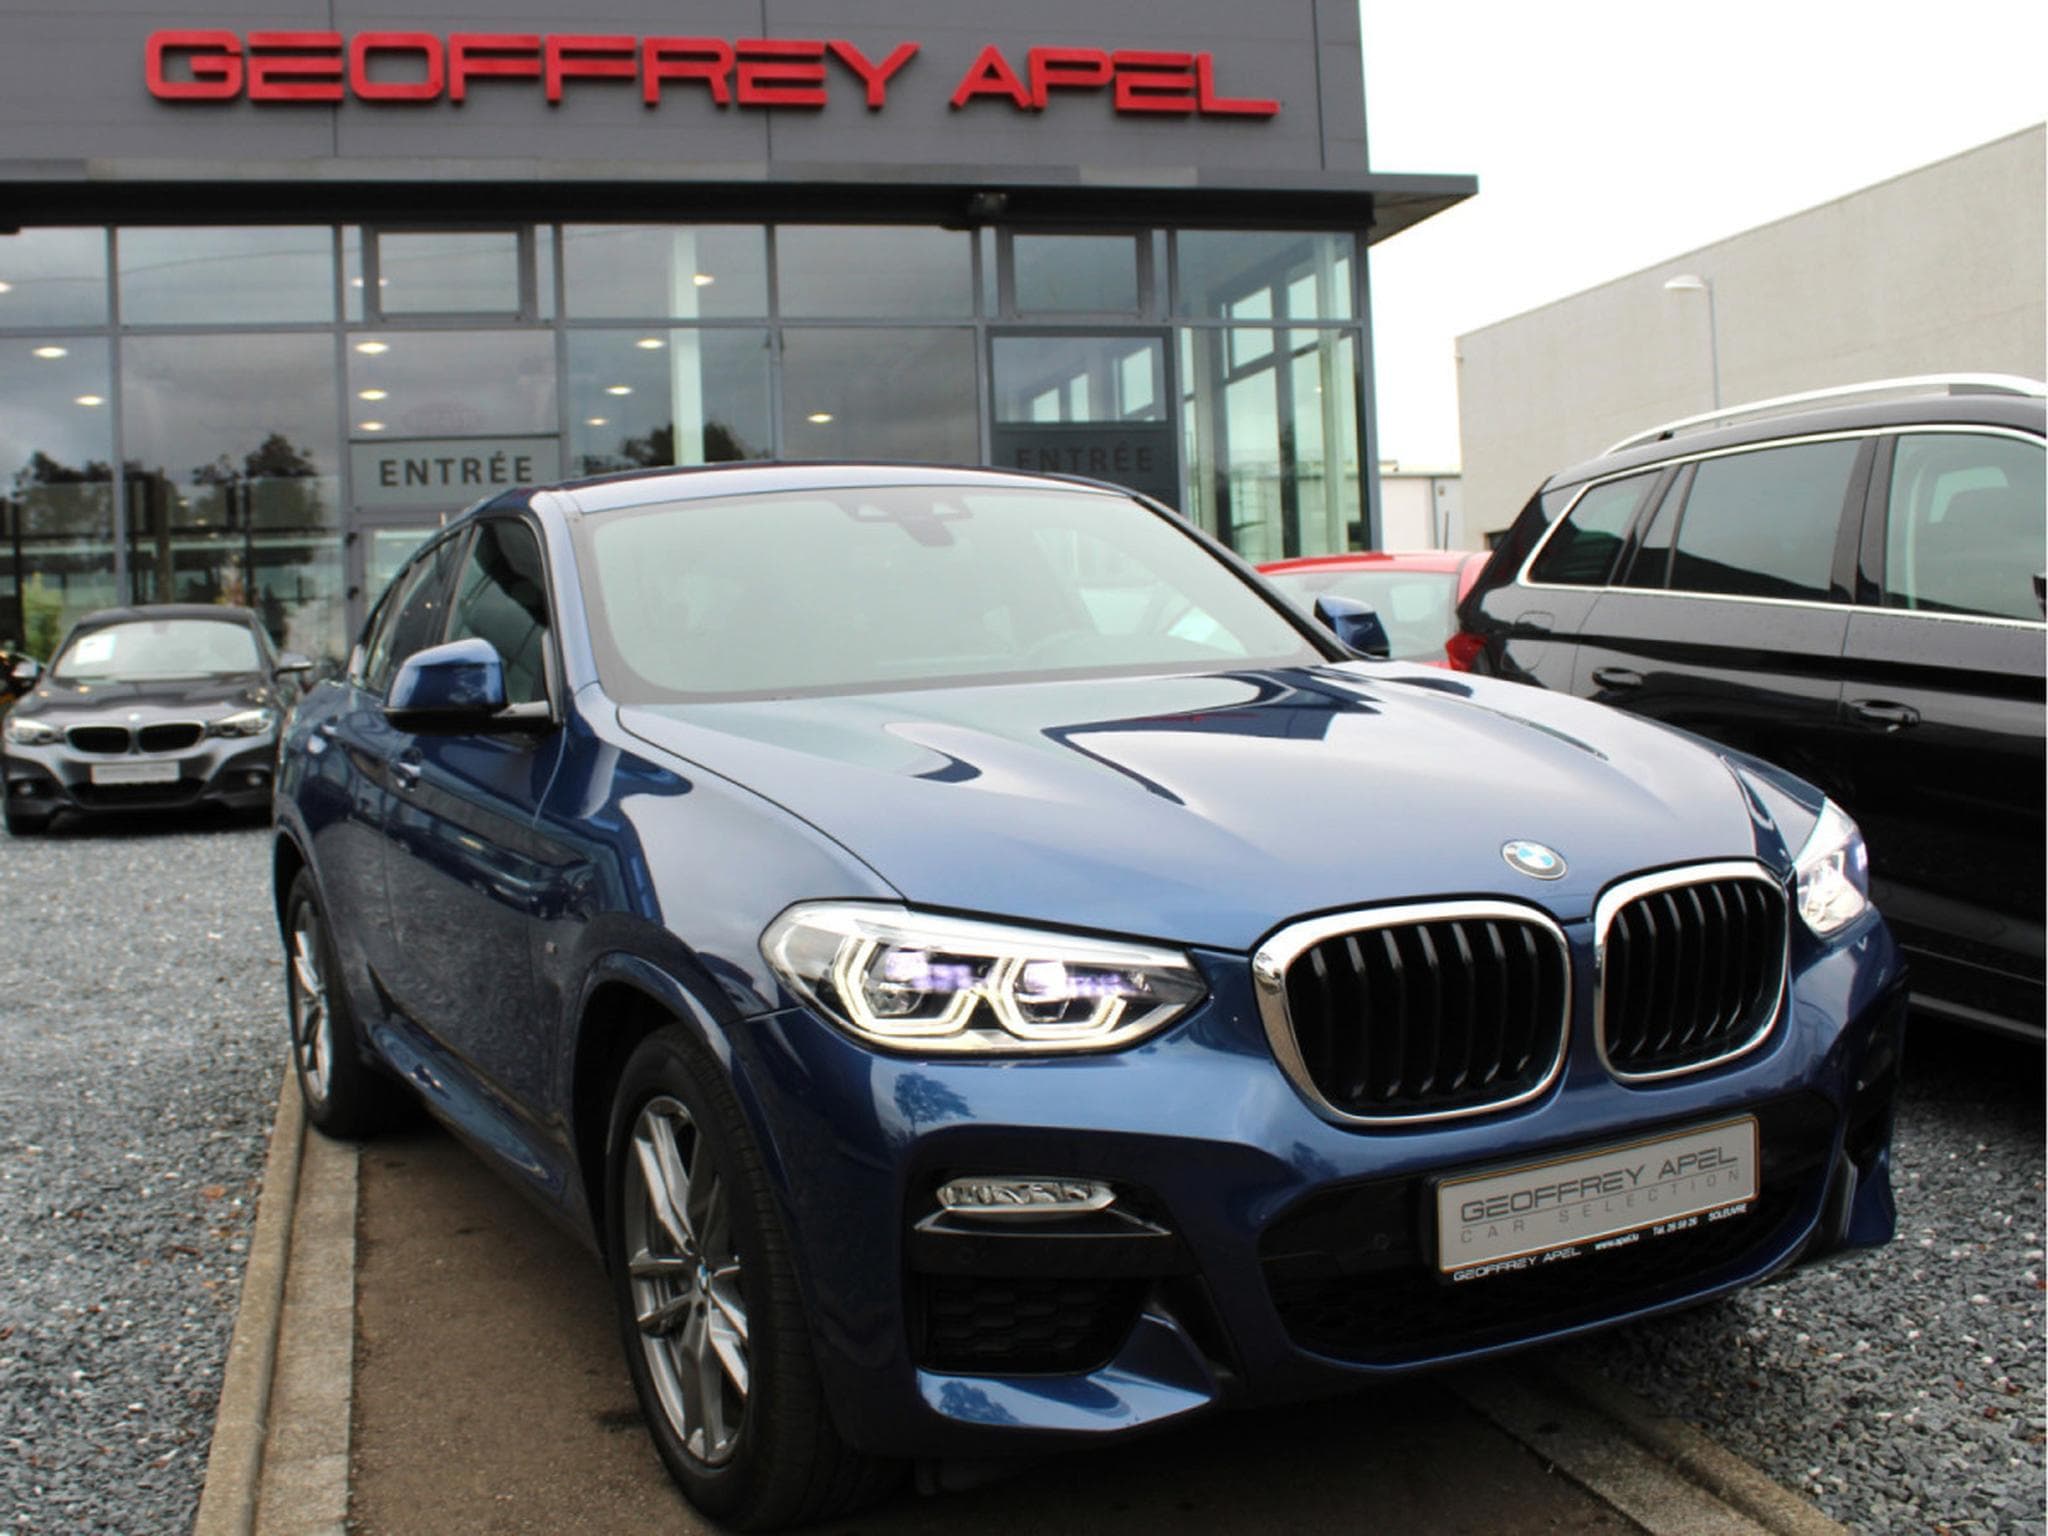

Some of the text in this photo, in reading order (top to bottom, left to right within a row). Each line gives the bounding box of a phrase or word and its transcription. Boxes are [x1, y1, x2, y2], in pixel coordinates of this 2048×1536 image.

[145, 29, 1280, 118] GEOFFREY APEL
[379, 450, 533, 486] ENTRÉE
[1460, 1146, 1738, 1223] GEOFFREY APEL
[1460, 1170, 1740, 1244] CAR SELECTION
[1453, 1256, 1537, 1282] GEOFFREY
[1543, 1247, 1581, 1264] APEL
